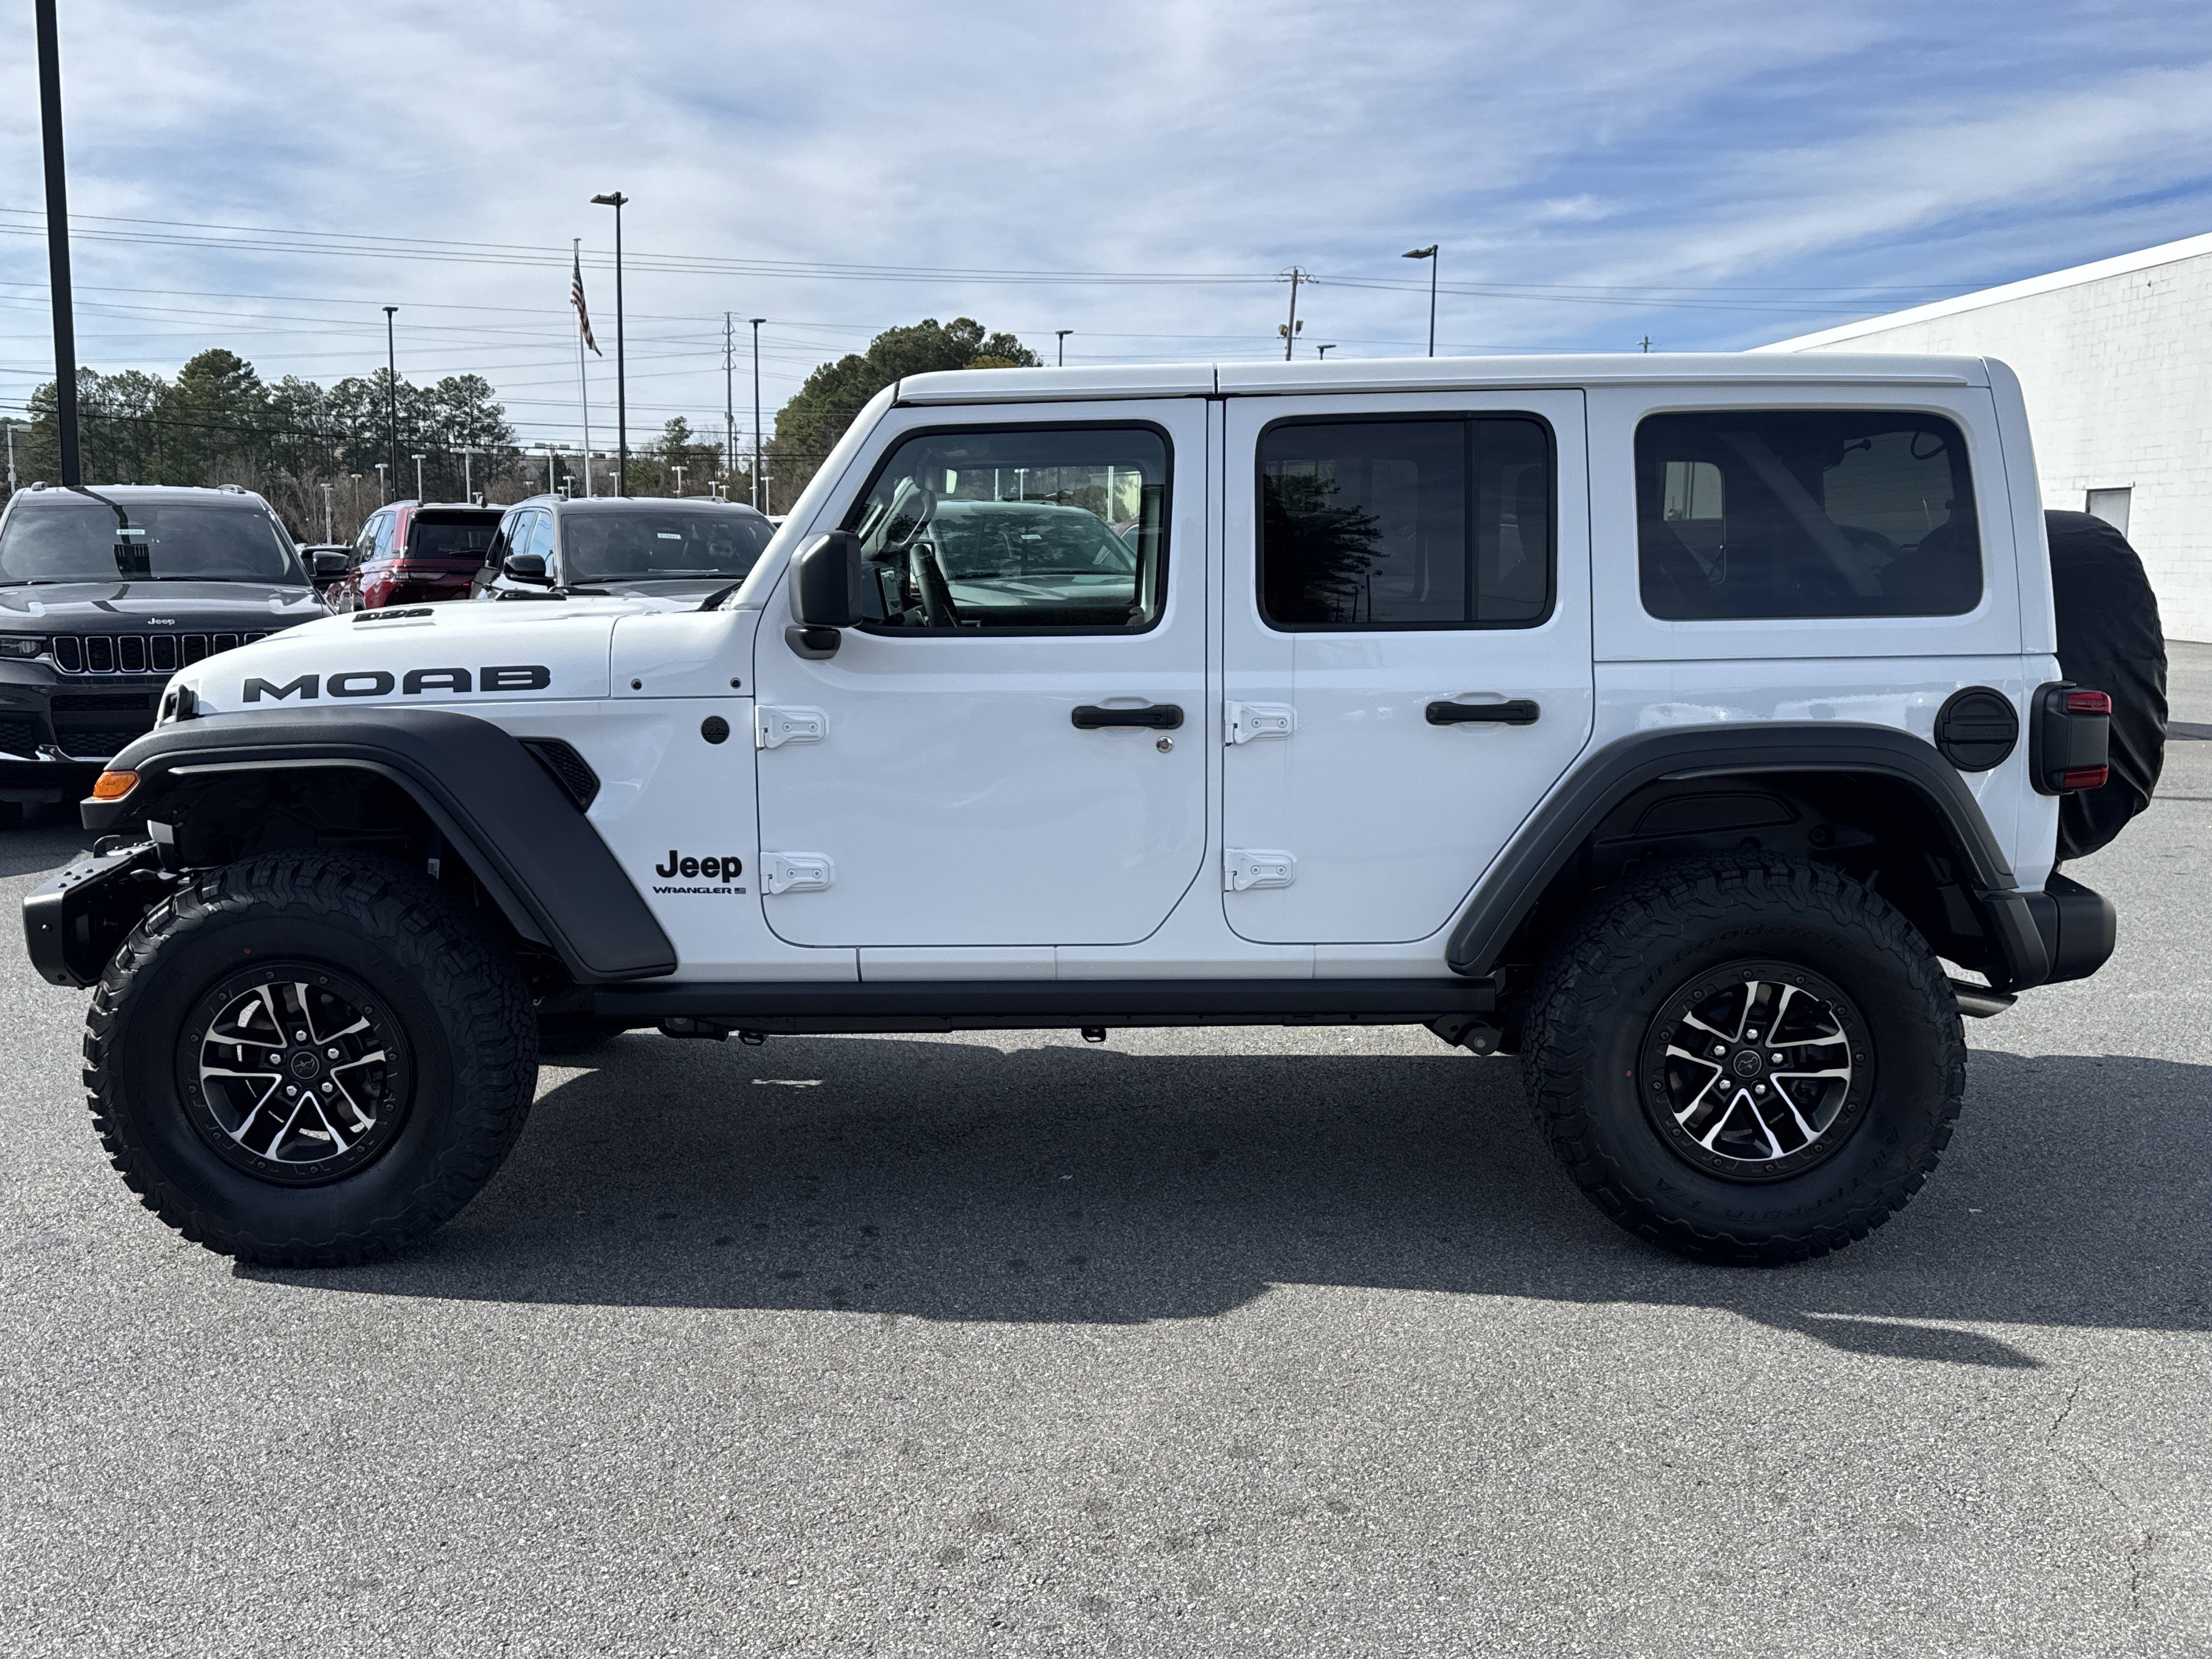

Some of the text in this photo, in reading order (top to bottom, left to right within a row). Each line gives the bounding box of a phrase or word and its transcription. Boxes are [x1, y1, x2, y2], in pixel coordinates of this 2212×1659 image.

[243, 665, 551, 703] MOAB
[656, 850, 742, 883] Jeep
[652, 886, 732, 894] WRANGLER
